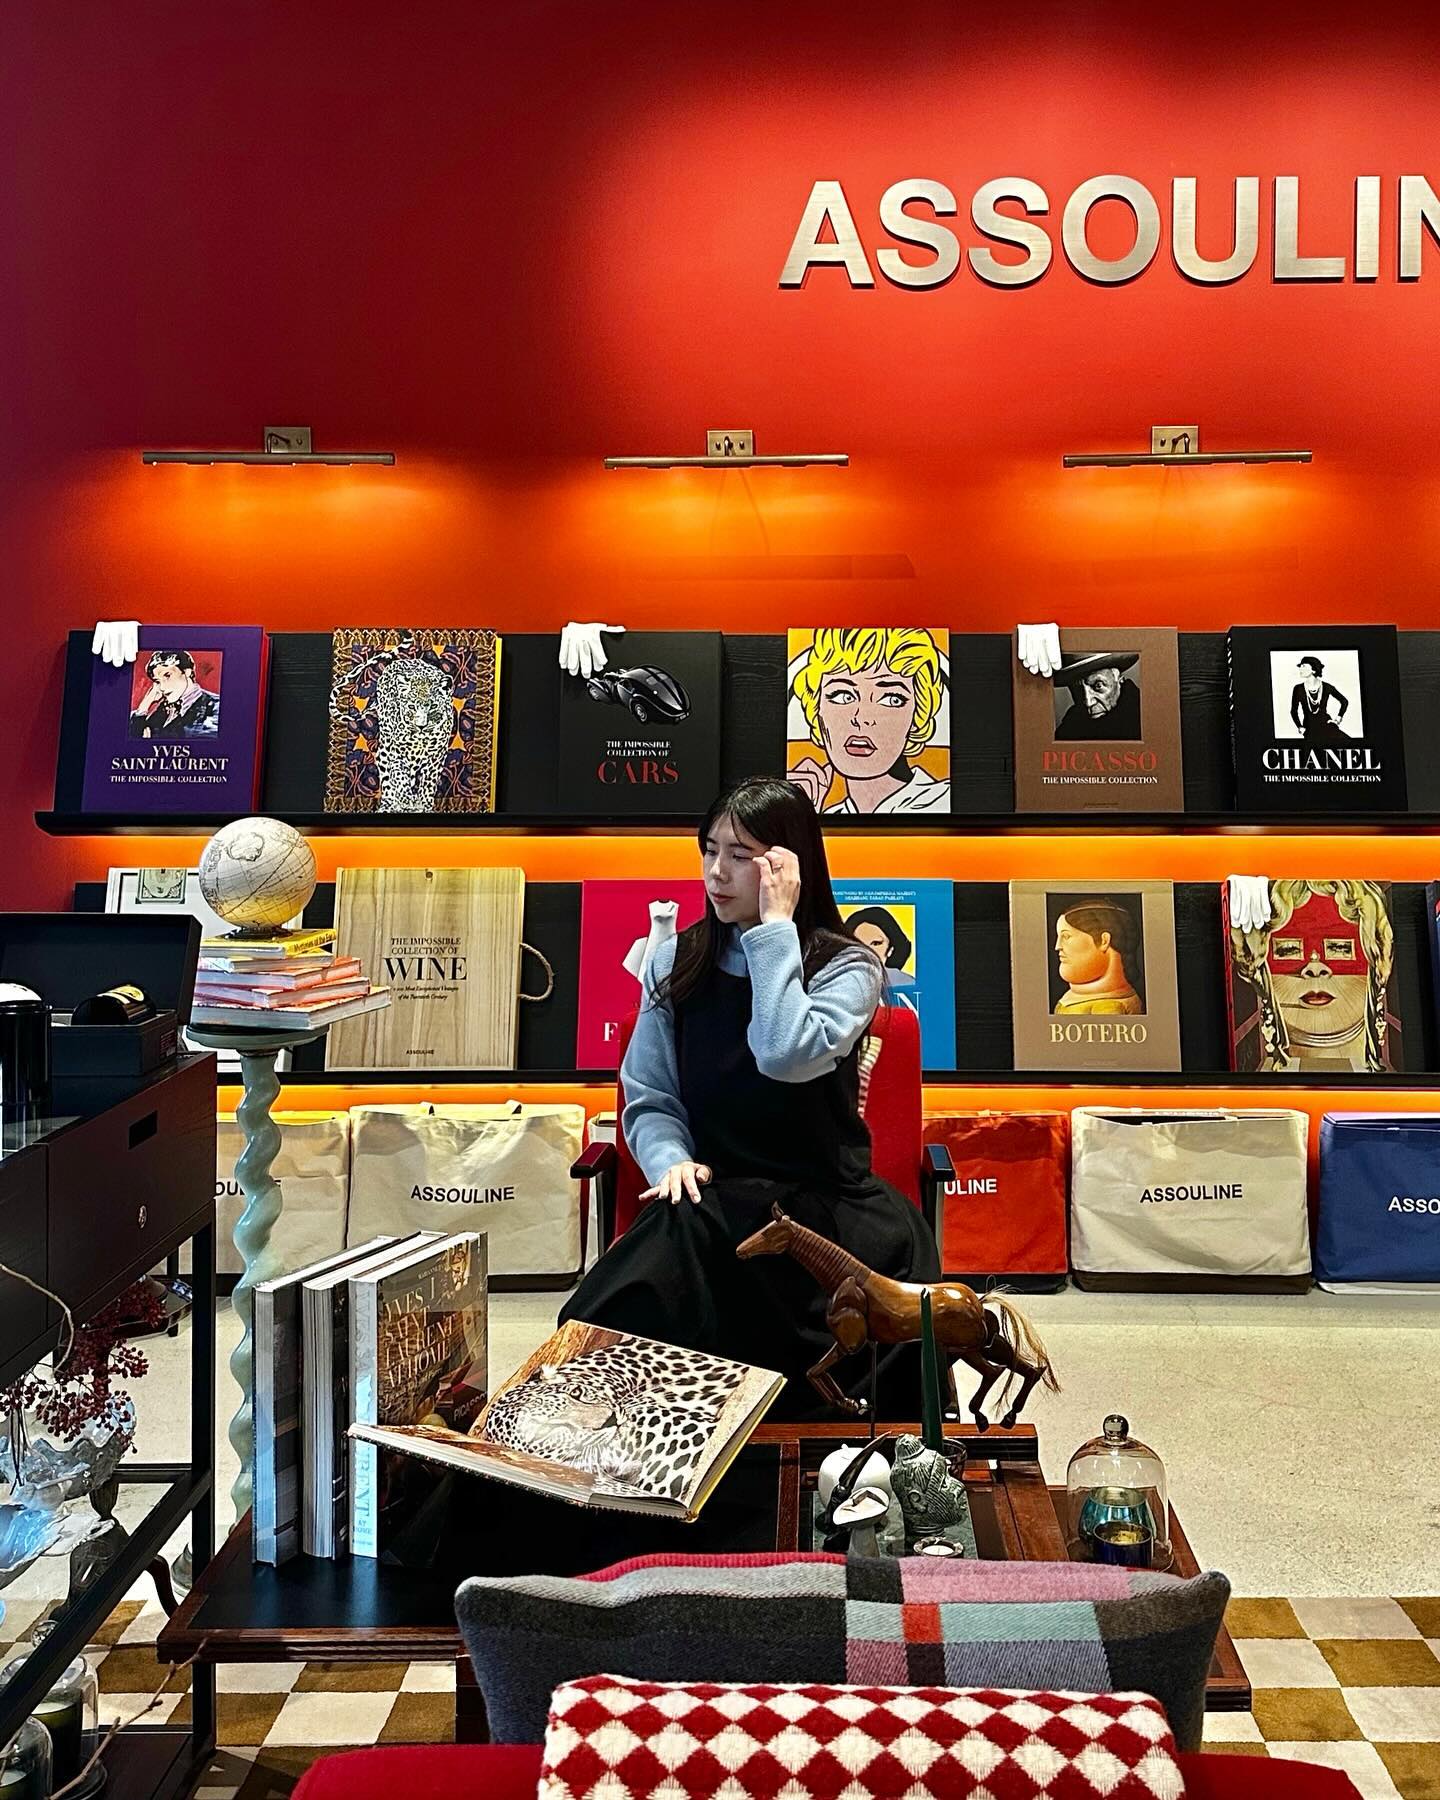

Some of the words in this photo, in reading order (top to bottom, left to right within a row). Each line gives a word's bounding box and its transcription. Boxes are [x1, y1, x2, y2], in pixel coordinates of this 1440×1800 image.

[152, 745, 190, 757] YVES
[606, 749, 657, 757] COLLECTION
[658, 749, 670, 757] OF
[1262, 748, 1381, 770] CHANEL
[111, 758, 157, 770] SAINT
[159, 758, 228, 770] LAURENT
[1042, 751, 1157, 772] PICASSO
[110, 775, 126, 783] THE
[128, 775, 176, 783] IMPOSSIBLE
[177, 775, 227, 783] COLLECTION
[596, 760, 680, 784] CARS
[1042, 776, 1059, 784] THE
[1060, 776, 1106, 784] IMPOSSIBLE
[1108, 776, 1158, 784] COLLECTION
[1264, 775, 1280, 783] THE
[1281, 775, 1329, 783] IMPOSSIBLE
[1330, 775, 1381, 783] COLLECTION
[391, 937, 409, 945] THE
[410, 937, 461, 945] IMPOSSIBLE
[391, 947, 446, 955] COLLECTION
[447, 947, 459, 955] OF
[383, 957, 468, 981] WINE
[1049, 1024, 1147, 1043] BOTERO
[411, 1179, 514, 1204] ASSOULINE
[944, 1178, 997, 1195] ULINE
[1140, 1184, 1243, 1203] ASSOULINE
[385, 1286, 424, 1322] YVES
